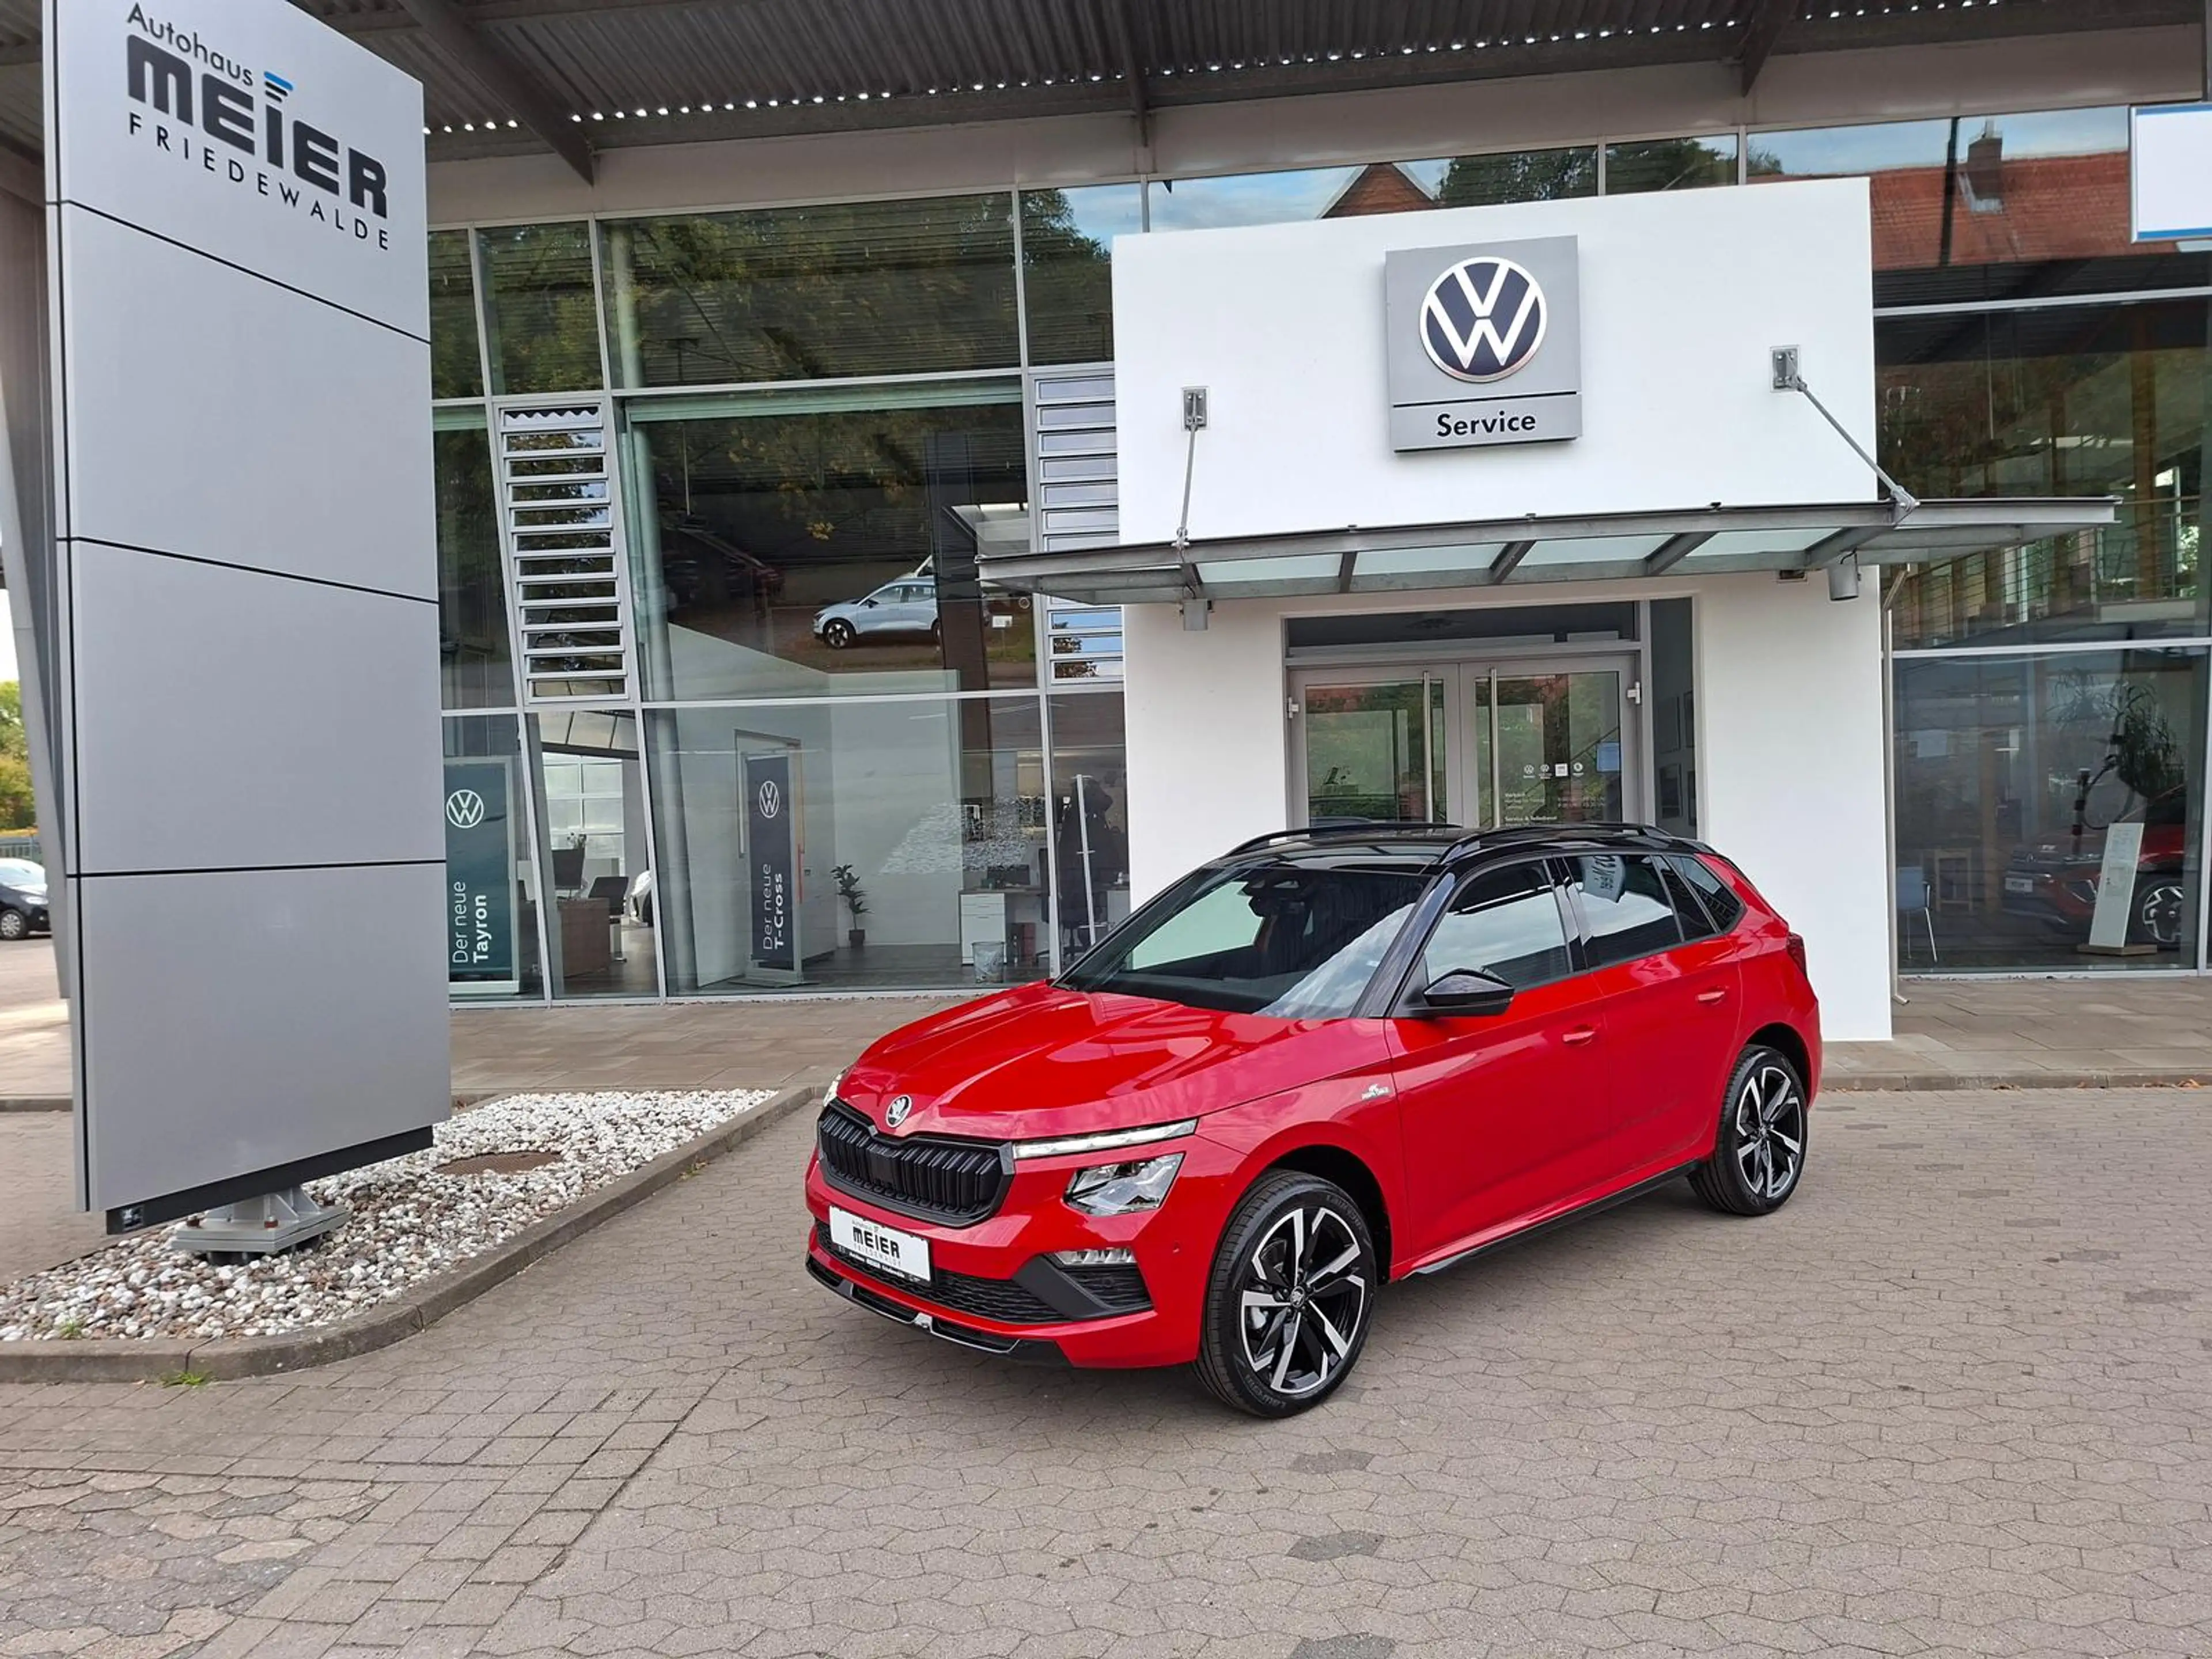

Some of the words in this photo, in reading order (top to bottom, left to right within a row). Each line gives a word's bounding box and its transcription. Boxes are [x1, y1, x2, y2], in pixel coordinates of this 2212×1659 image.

[127, 2, 253, 86] Autohaus
[127, 34, 388, 219] MEIER
[129, 112, 388, 250] FRIEDEWALDE
[1419, 256, 1547, 382] VW
[1437, 410, 1536, 437] Service
[453, 881, 466, 926] neue
[763, 863, 772, 911] neue
[774, 873, 784, 949] T-Cross
[452, 931, 469, 964] Der
[473, 895, 492, 963] Tayron
[763, 915, 773, 949] Der
[853, 1226, 900, 1259] MEIER
